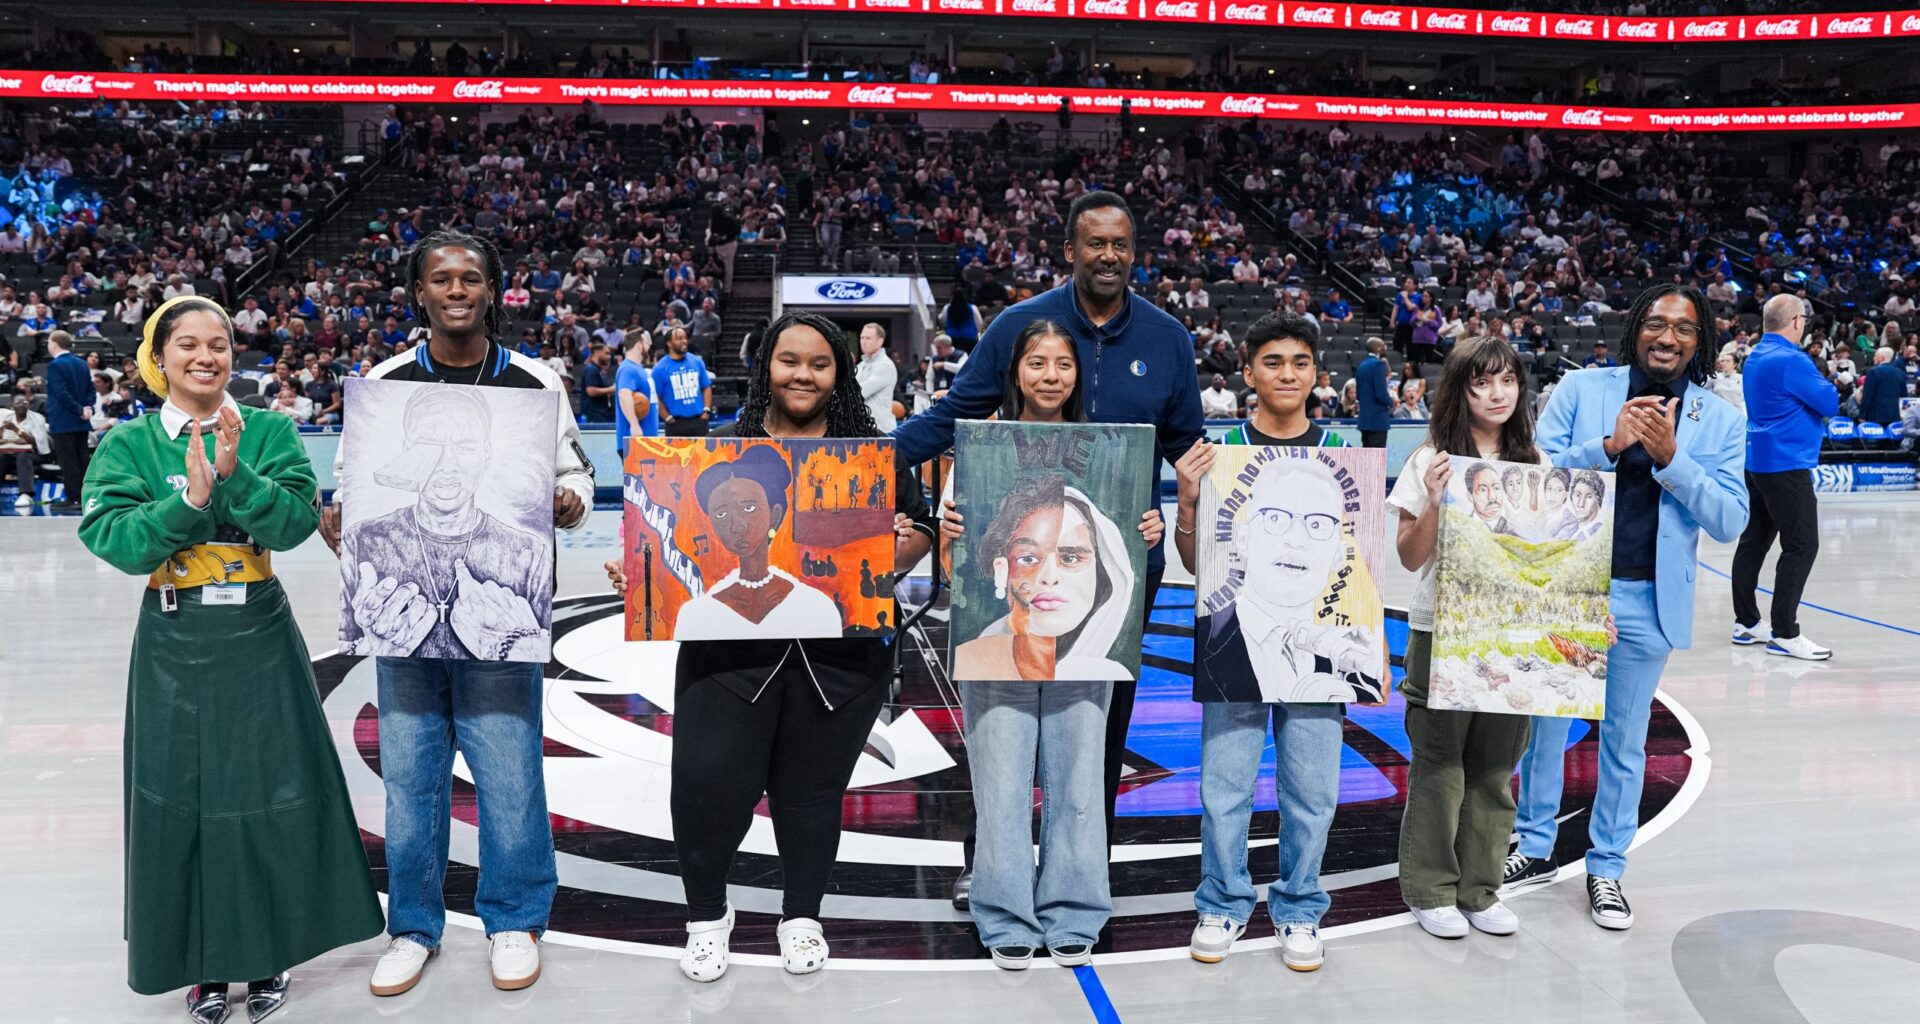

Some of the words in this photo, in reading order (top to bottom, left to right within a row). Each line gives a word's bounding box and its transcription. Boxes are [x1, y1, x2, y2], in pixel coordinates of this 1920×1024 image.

[1155, 1, 1198, 17] Coca-Cola
[1225, 4, 1267, 20] Coca-Cola
[1293, 7, 1335, 23] Coca-Cola
[1361, 10, 1401, 26] Coca-Cola
[1426, 13, 1467, 29] Coca-Cola
[1491, 16, 1530, 32] Coca-Cola
[1827, 18, 1873, 33] Coca-Cola
[1555, 19, 1593, 35] Coca-Cola
[1618, 22, 1658, 37] Coca-Cola
[1684, 21, 1728, 37] Coca-Cola
[1755, 20, 1800, 35] Coca-Cola
[41, 75, 94, 93] Coca-Cola
[154, 80, 204, 92] There's
[206, 81, 247, 94] magic
[249, 82, 286, 93] when
[289, 84, 310, 93] we
[312, 83, 375, 94] celebrate
[377, 84, 435, 96] together
[453, 81, 503, 98] Coca-Cola
[560, 85, 608, 96] There's
[610, 86, 649, 98] magic
[651, 86, 687, 97] when
[689, 89, 710, 98] we
[712, 87, 773, 98] celebrate
[774, 88, 831, 101] together
[848, 86, 896, 103] Coca-Cola
[950, 91, 996, 103] There's
[998, 93, 1035, 105] magic
[1037, 94, 1062, 104] whe
[1073, 96, 1092, 105] we
[1094, 95, 1151, 107] celeate
[1153, 97, 1205, 110] together
[1221, 96, 1265, 113] Coca-Cola
[1316, 103, 1357, 114] There's
[1359, 105, 1393, 116] magic
[1395, 106, 1426, 116] when
[1428, 109, 1445, 117] we
[1447, 108, 1498, 119] celebrate
[1500, 110, 1548, 121] together
[1562, 109, 1603, 125] Coca-Cola
[1649, 115, 1691, 124] There's
[1694, 114, 1729, 126] magic
[1732, 114, 1765, 123] when
[1768, 115, 1786, 123] we
[1788, 113, 1846, 123] celebrate
[1848, 111, 1904, 123] together
[827, 281, 866, 299] Ford
[1809, 464, 1853, 481] TSW
[1334, 466, 1361, 513] DOES
